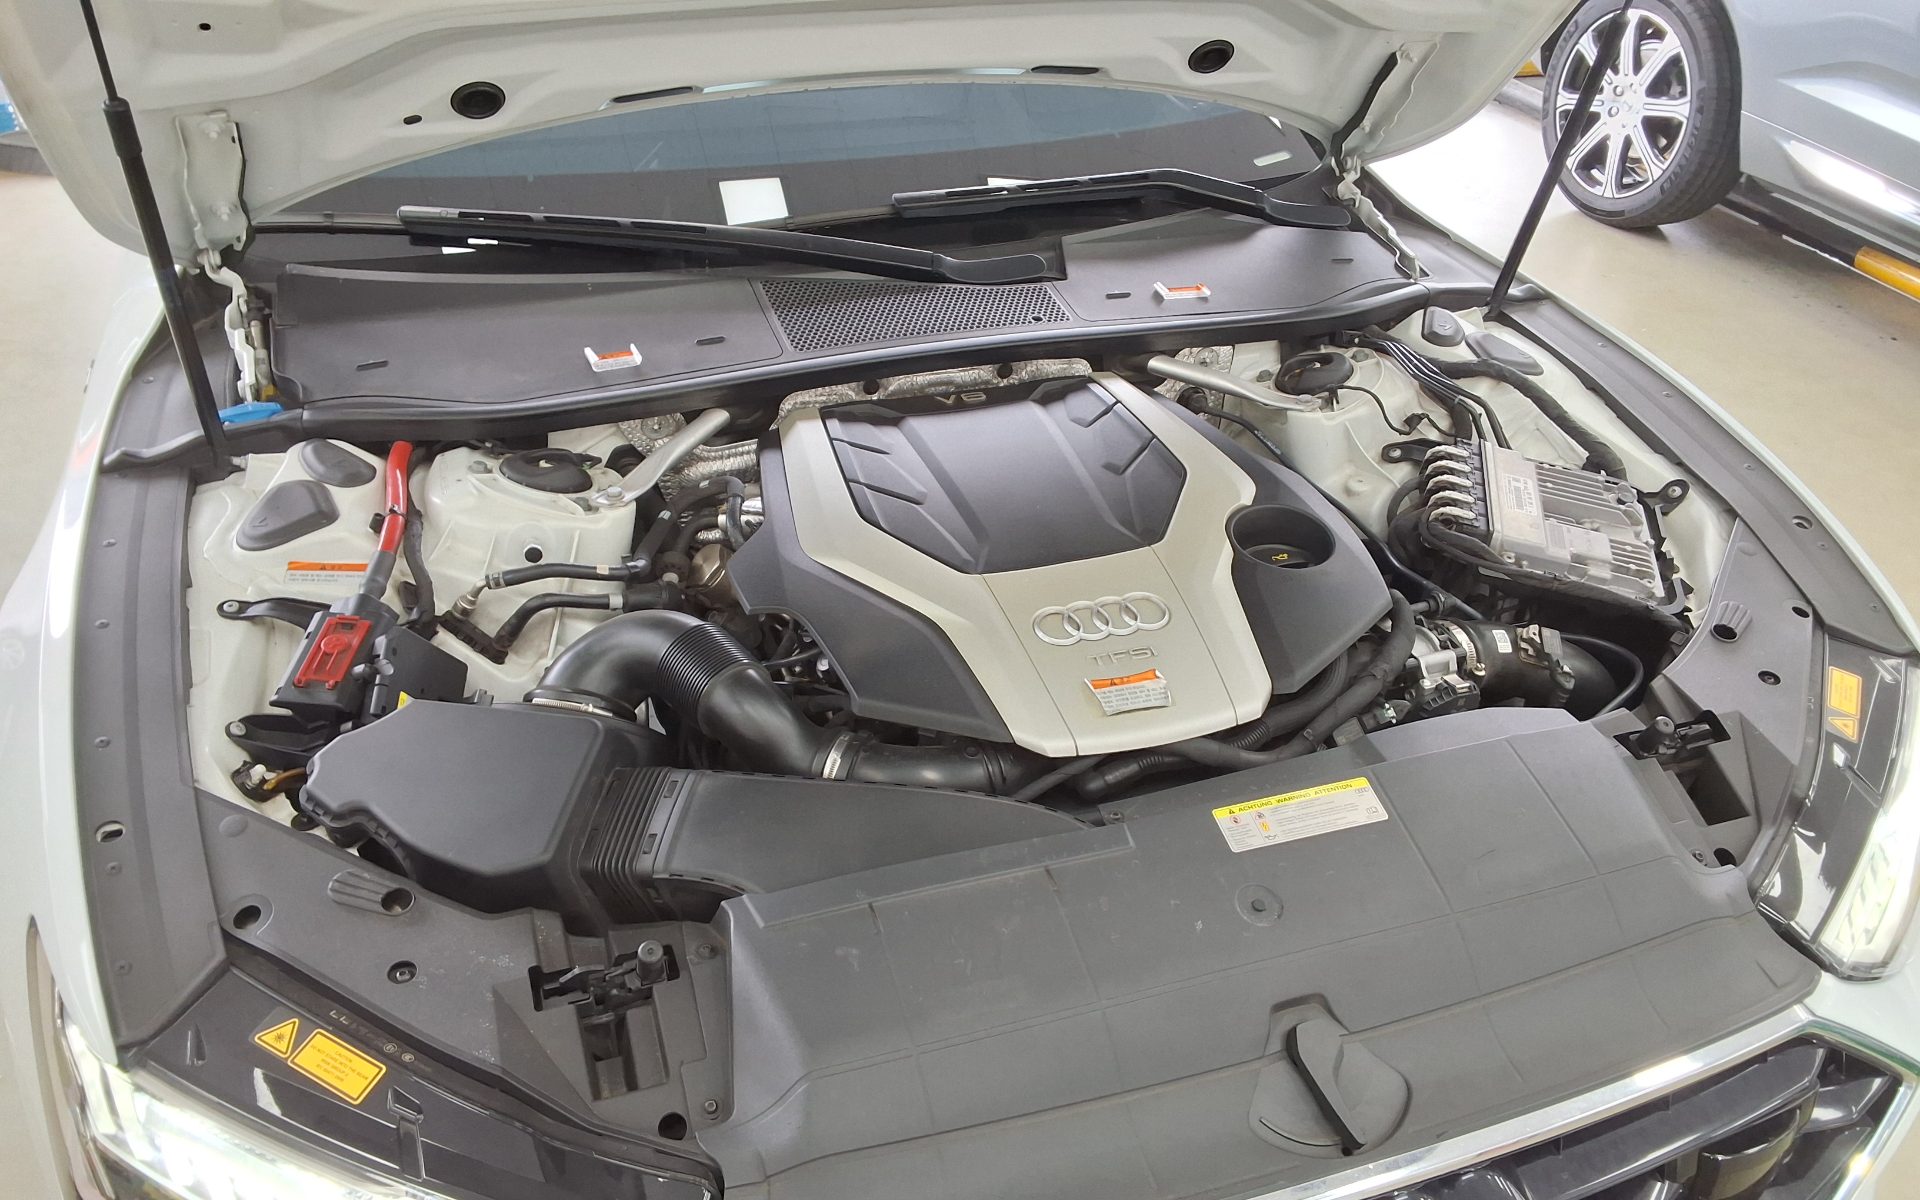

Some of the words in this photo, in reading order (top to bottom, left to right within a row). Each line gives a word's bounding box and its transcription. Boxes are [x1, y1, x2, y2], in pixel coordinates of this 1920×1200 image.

[934, 392, 986, 404] V6
[1087, 646, 1158, 666] TFSI
[1238, 801, 1273, 812] ACHTUNG
[1276, 792, 1311, 804] WARNING
[1315, 783, 1353, 795] ATTENTION
